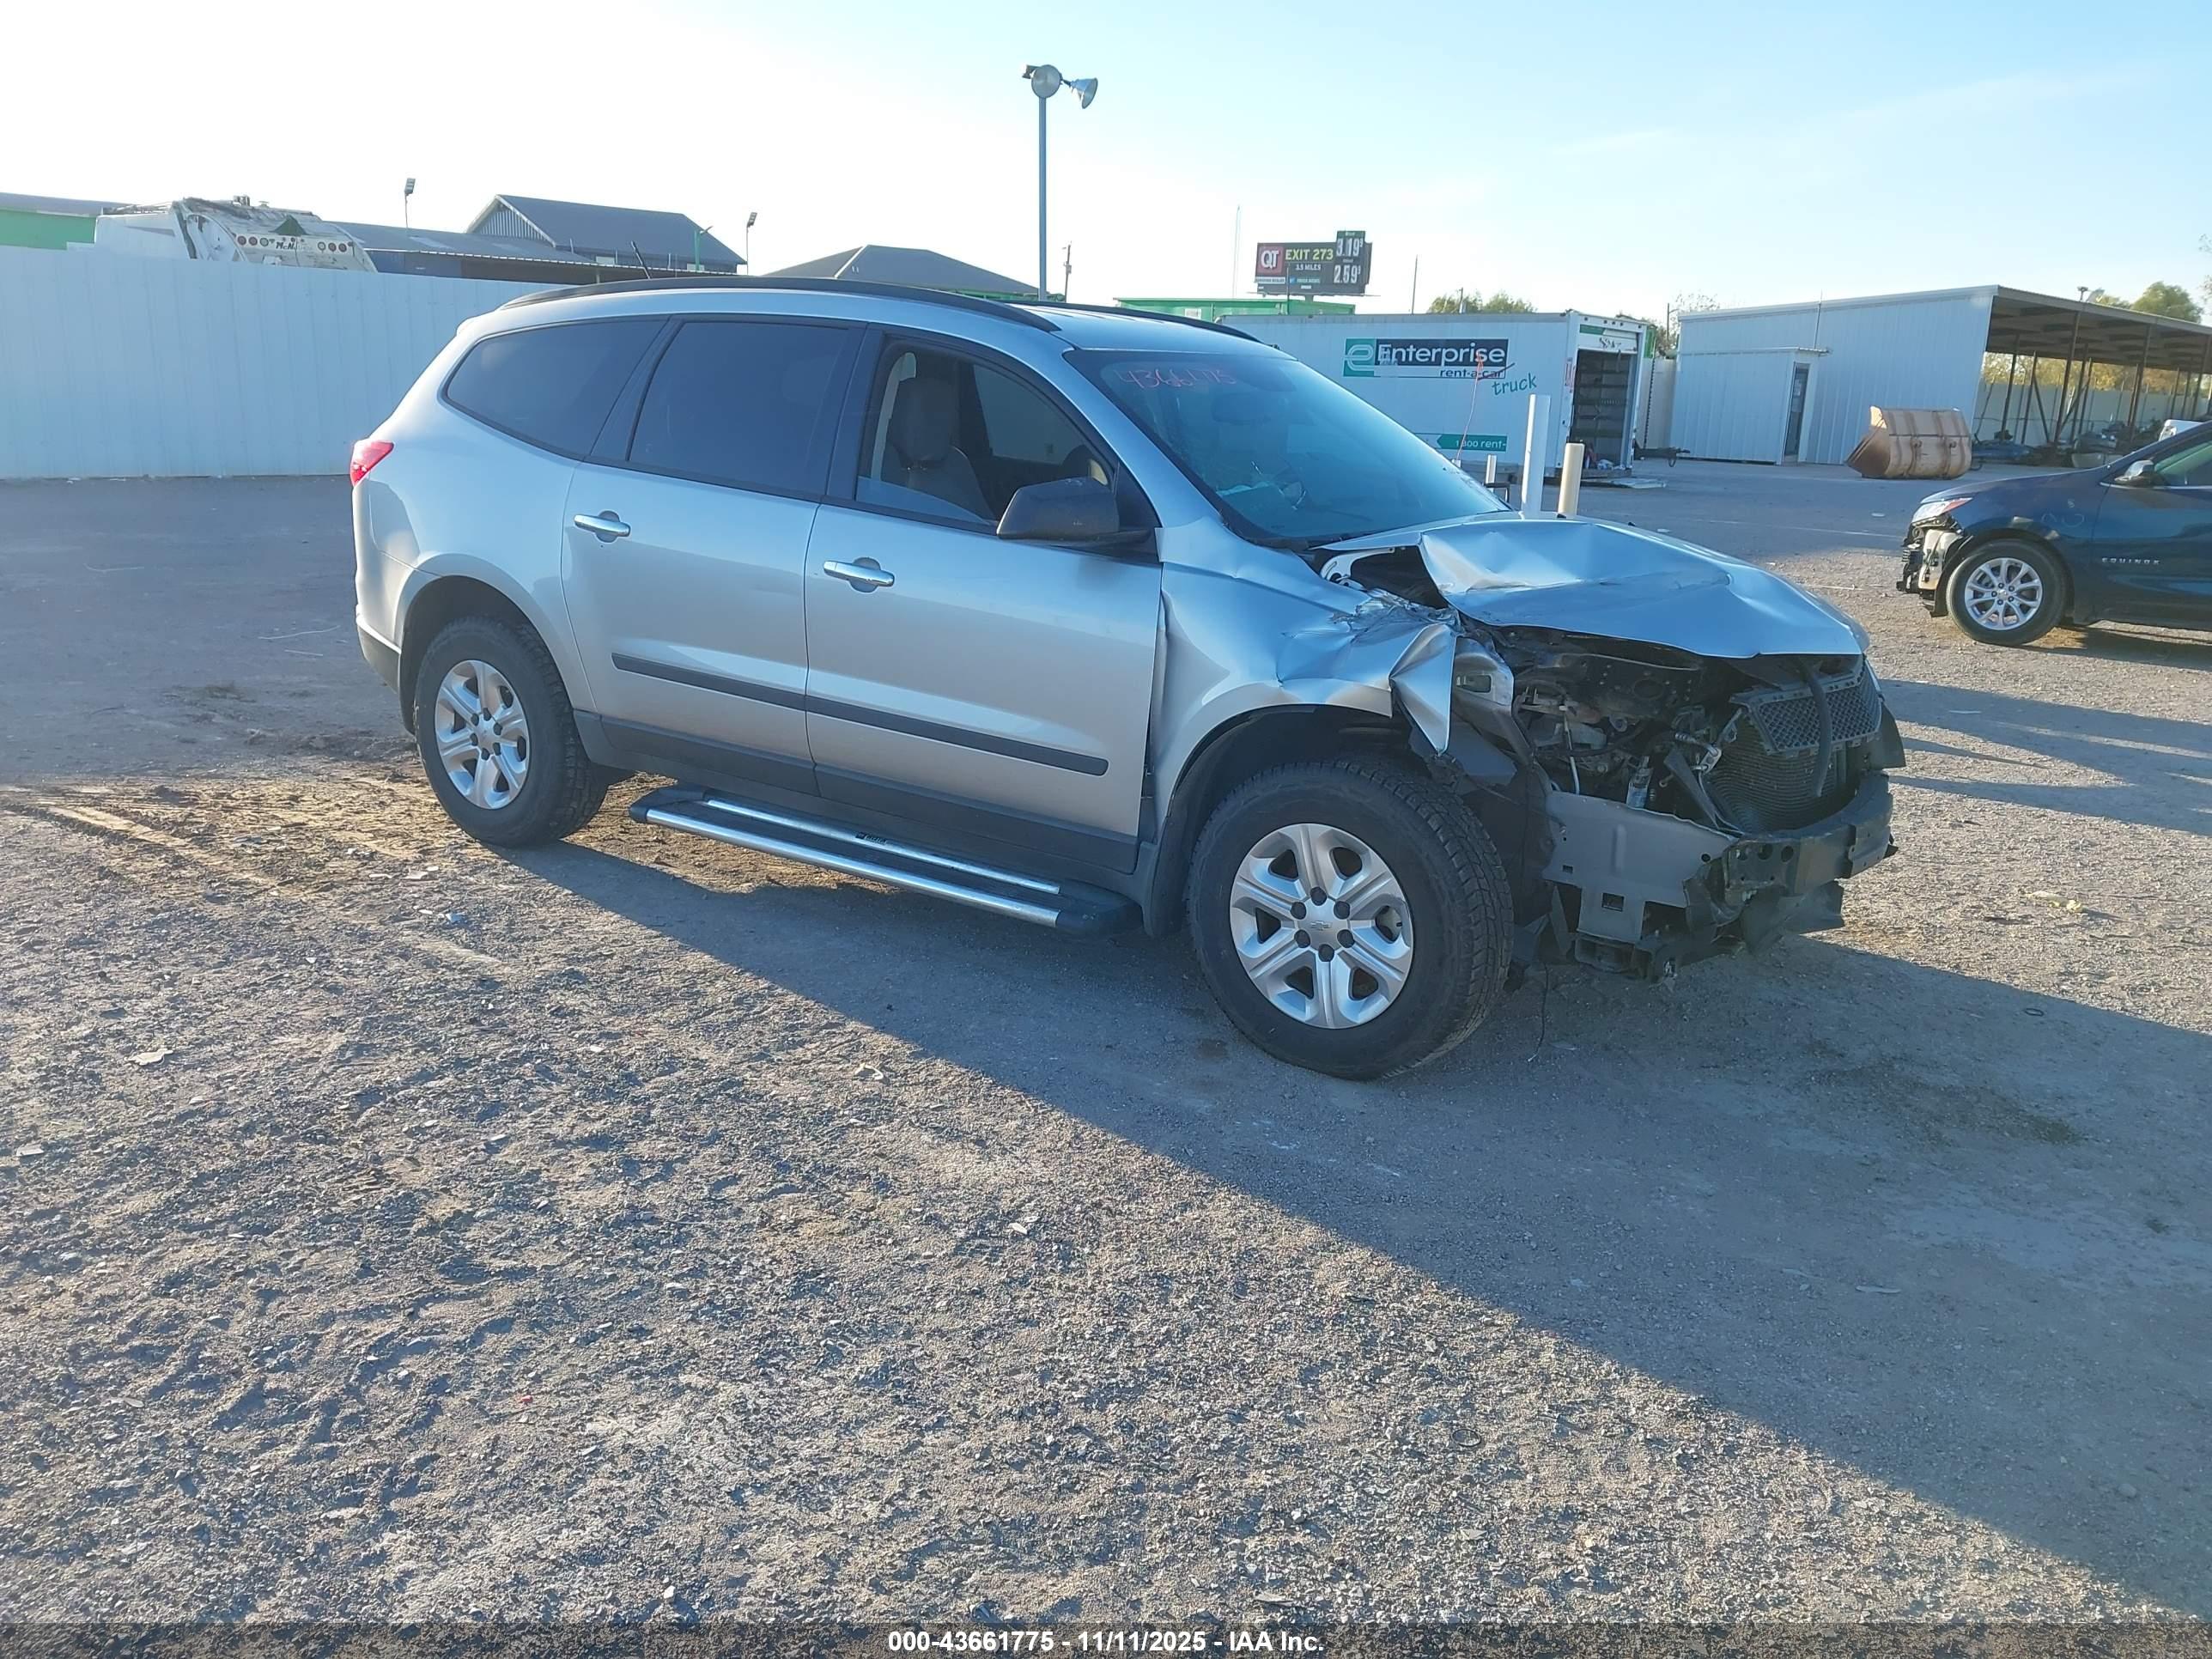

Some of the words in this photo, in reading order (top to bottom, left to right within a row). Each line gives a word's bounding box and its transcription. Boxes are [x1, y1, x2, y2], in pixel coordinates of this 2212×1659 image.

[1261, 250, 1279, 269] QT
[1285, 249, 1310, 260] EXIT
[1312, 249, 1334, 260] 273
[1377, 343, 1505, 367] Enterprise
[1439, 368, 1504, 379] rent-a-car
[1491, 373, 1538, 396] truck
